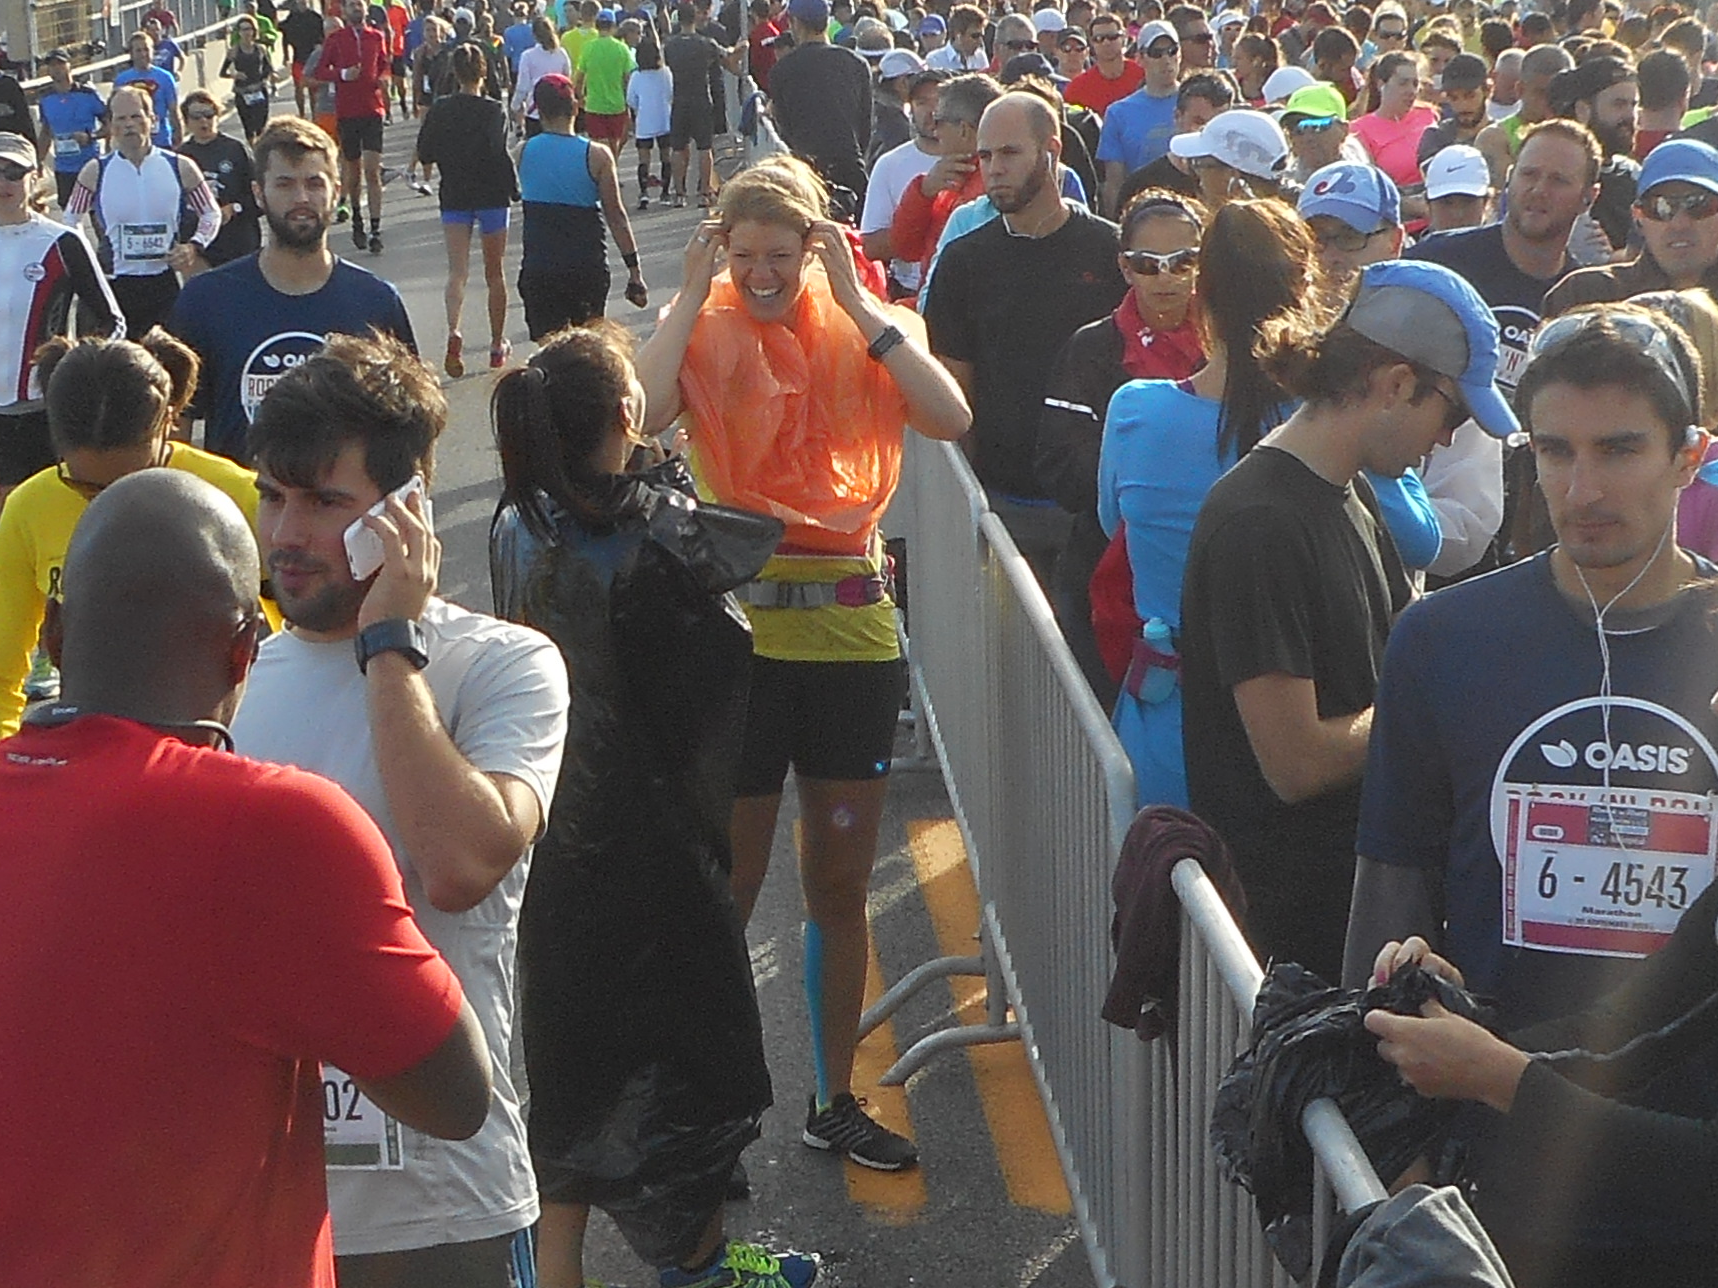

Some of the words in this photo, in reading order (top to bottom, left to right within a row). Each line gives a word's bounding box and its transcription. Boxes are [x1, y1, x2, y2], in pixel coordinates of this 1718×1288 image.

[1585, 741, 1689, 775] OASIS
[1538, 856, 1558, 899] 6
[1600, 861, 1689, 910] 4543
